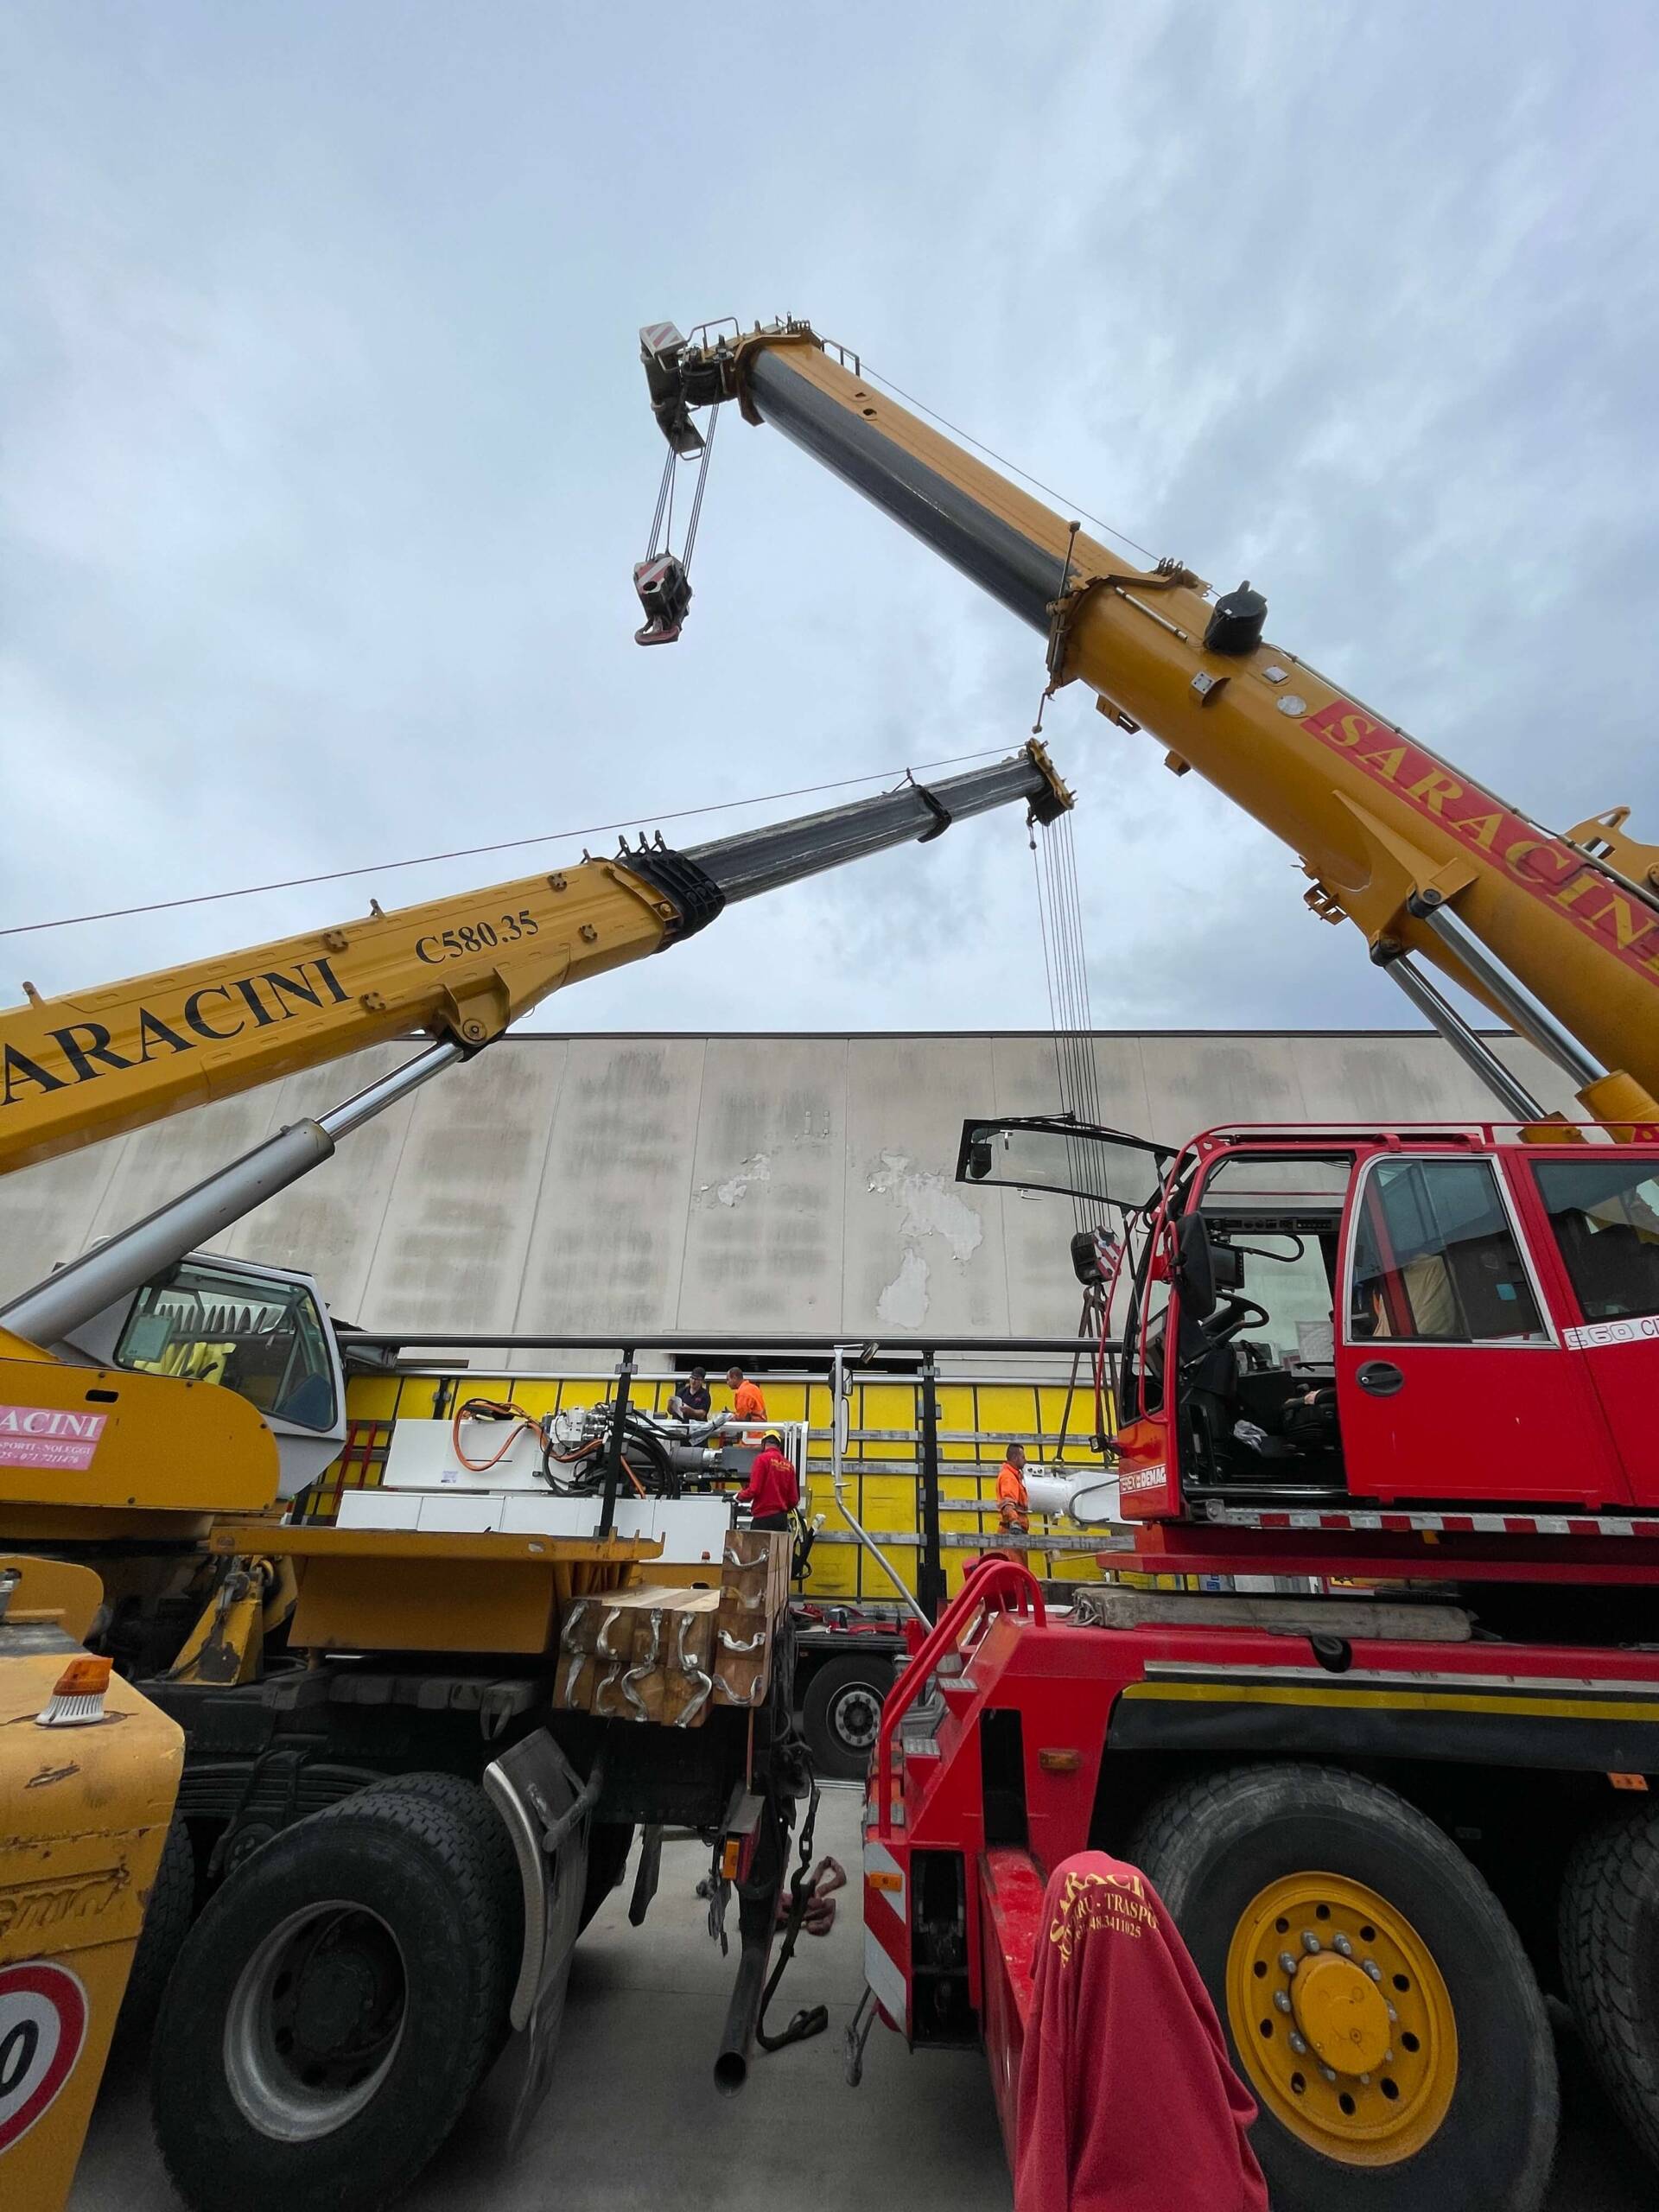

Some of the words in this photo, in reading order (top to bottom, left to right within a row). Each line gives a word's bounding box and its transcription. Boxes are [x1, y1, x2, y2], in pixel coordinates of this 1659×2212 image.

[1321, 715, 1659, 976] SARACIN
[415, 910, 539, 964] C580.35
[0, 957, 353, 1106] ARACINI
[1641, 1318, 1659, 1336] CI
[1141, 1467, 1166, 1488] DEMAG
